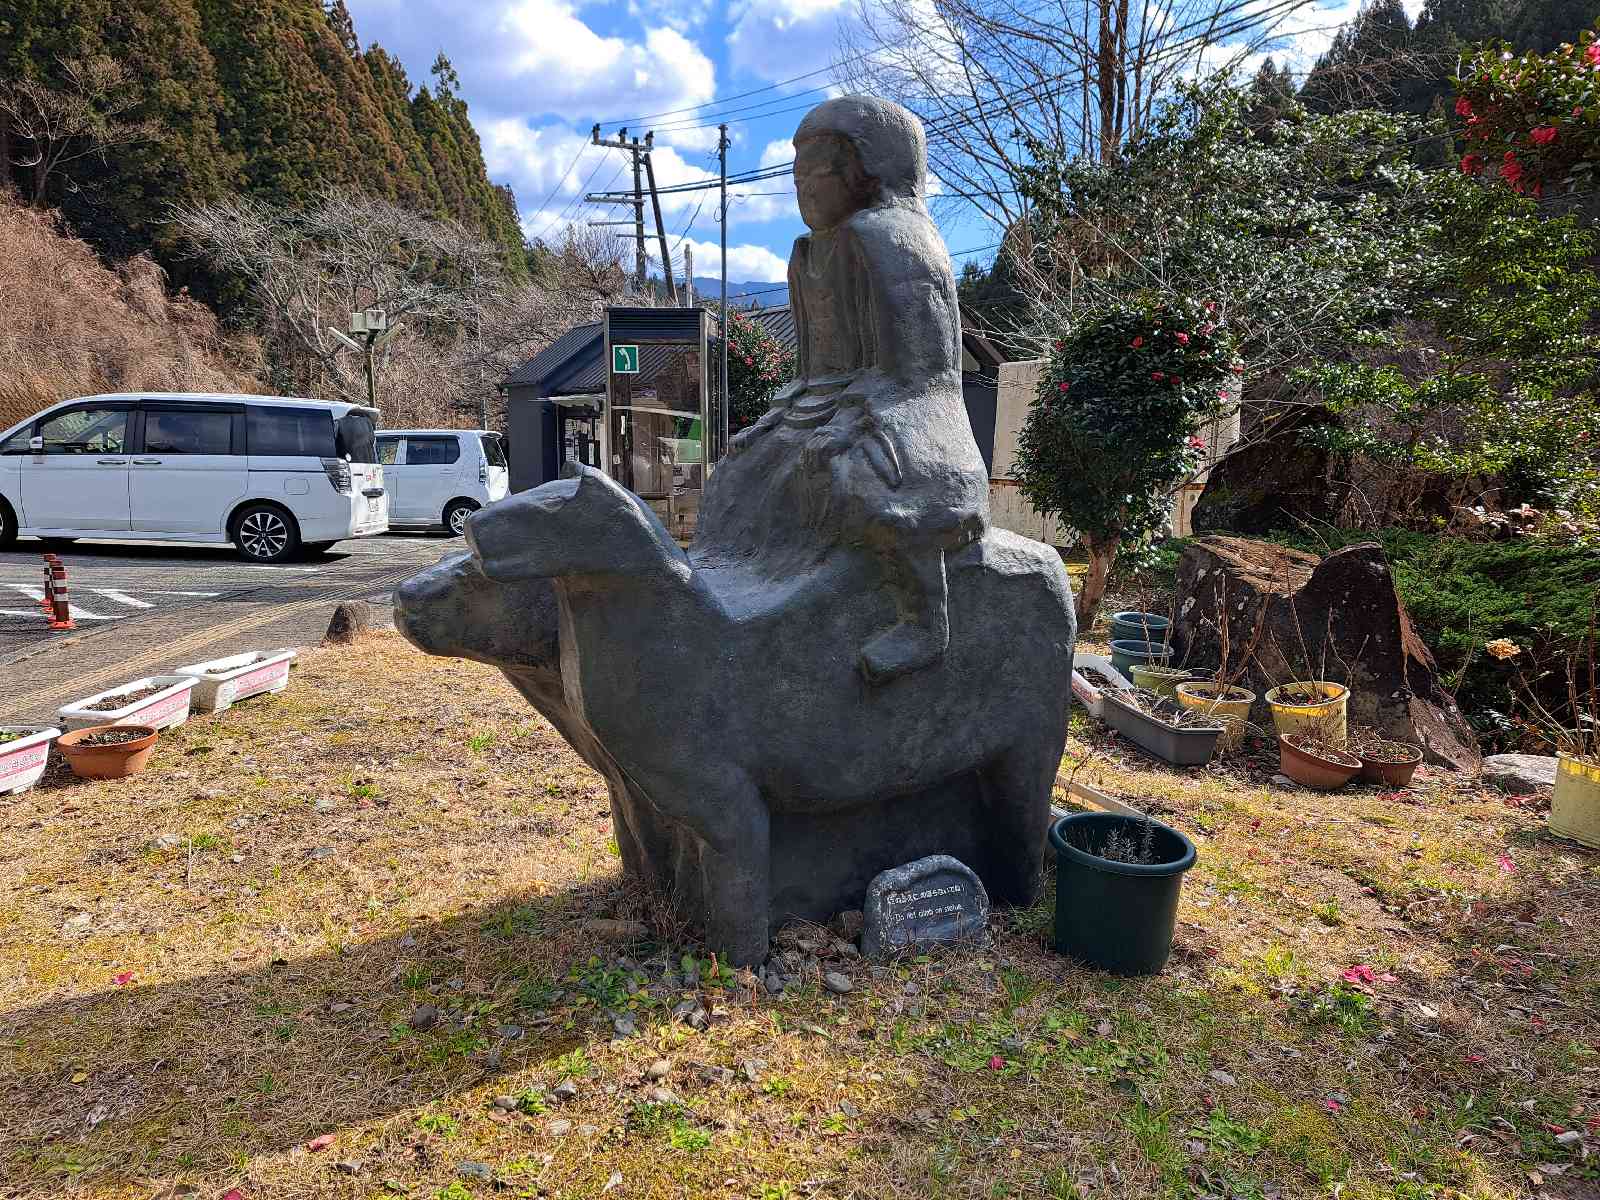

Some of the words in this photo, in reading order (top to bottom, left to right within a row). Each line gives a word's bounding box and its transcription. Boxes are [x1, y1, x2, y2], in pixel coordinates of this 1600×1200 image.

[895, 912, 904, 922] Do
[907, 910, 916, 920] not
[919, 907, 934, 917] climb
[935, 906, 943, 914] on
